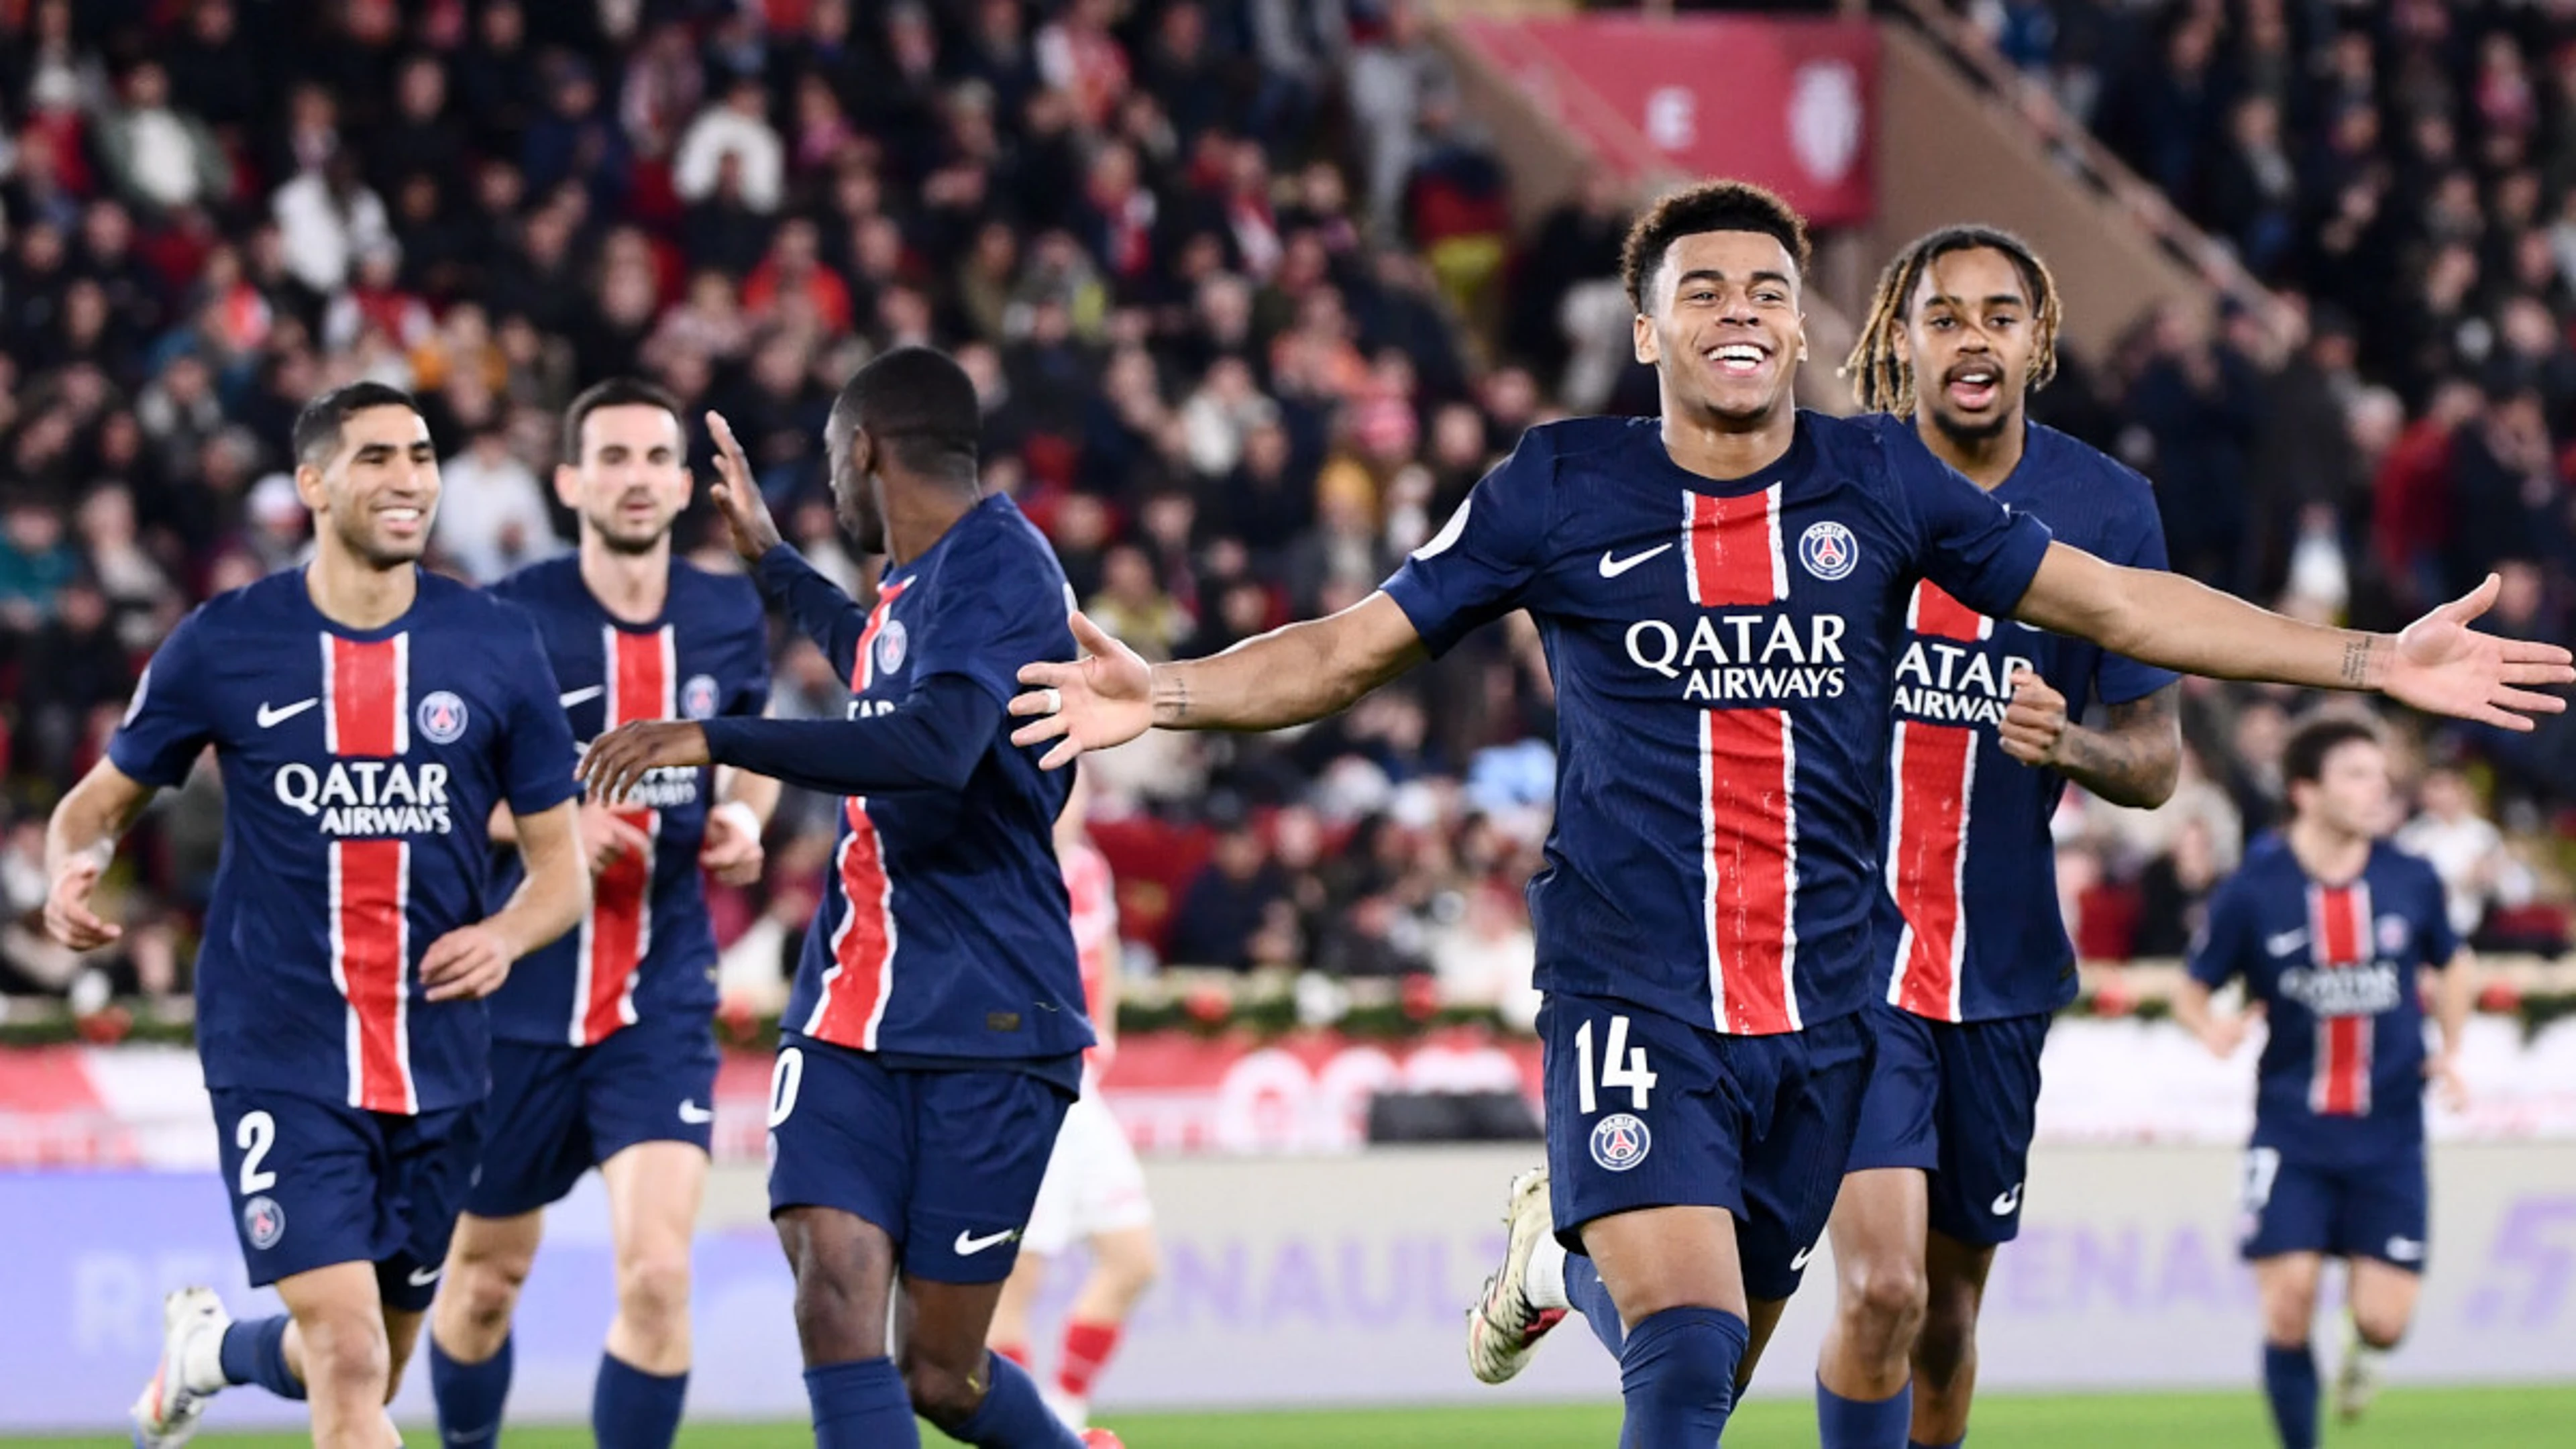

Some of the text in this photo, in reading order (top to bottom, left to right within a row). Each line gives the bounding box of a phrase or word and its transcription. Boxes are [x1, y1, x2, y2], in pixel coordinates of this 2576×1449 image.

[1625, 613, 1845, 679] QATAR
[1894, 641, 2033, 699] ATAR
[1682, 667, 1845, 700] AIRWAYS
[1892, 685, 2008, 725] AIRWA
[274, 761, 449, 816] QATAR
[319, 805, 452, 835] AIRWAYS
[1575, 1014, 1658, 1114] 14
[236, 1110, 276, 1195] 2
